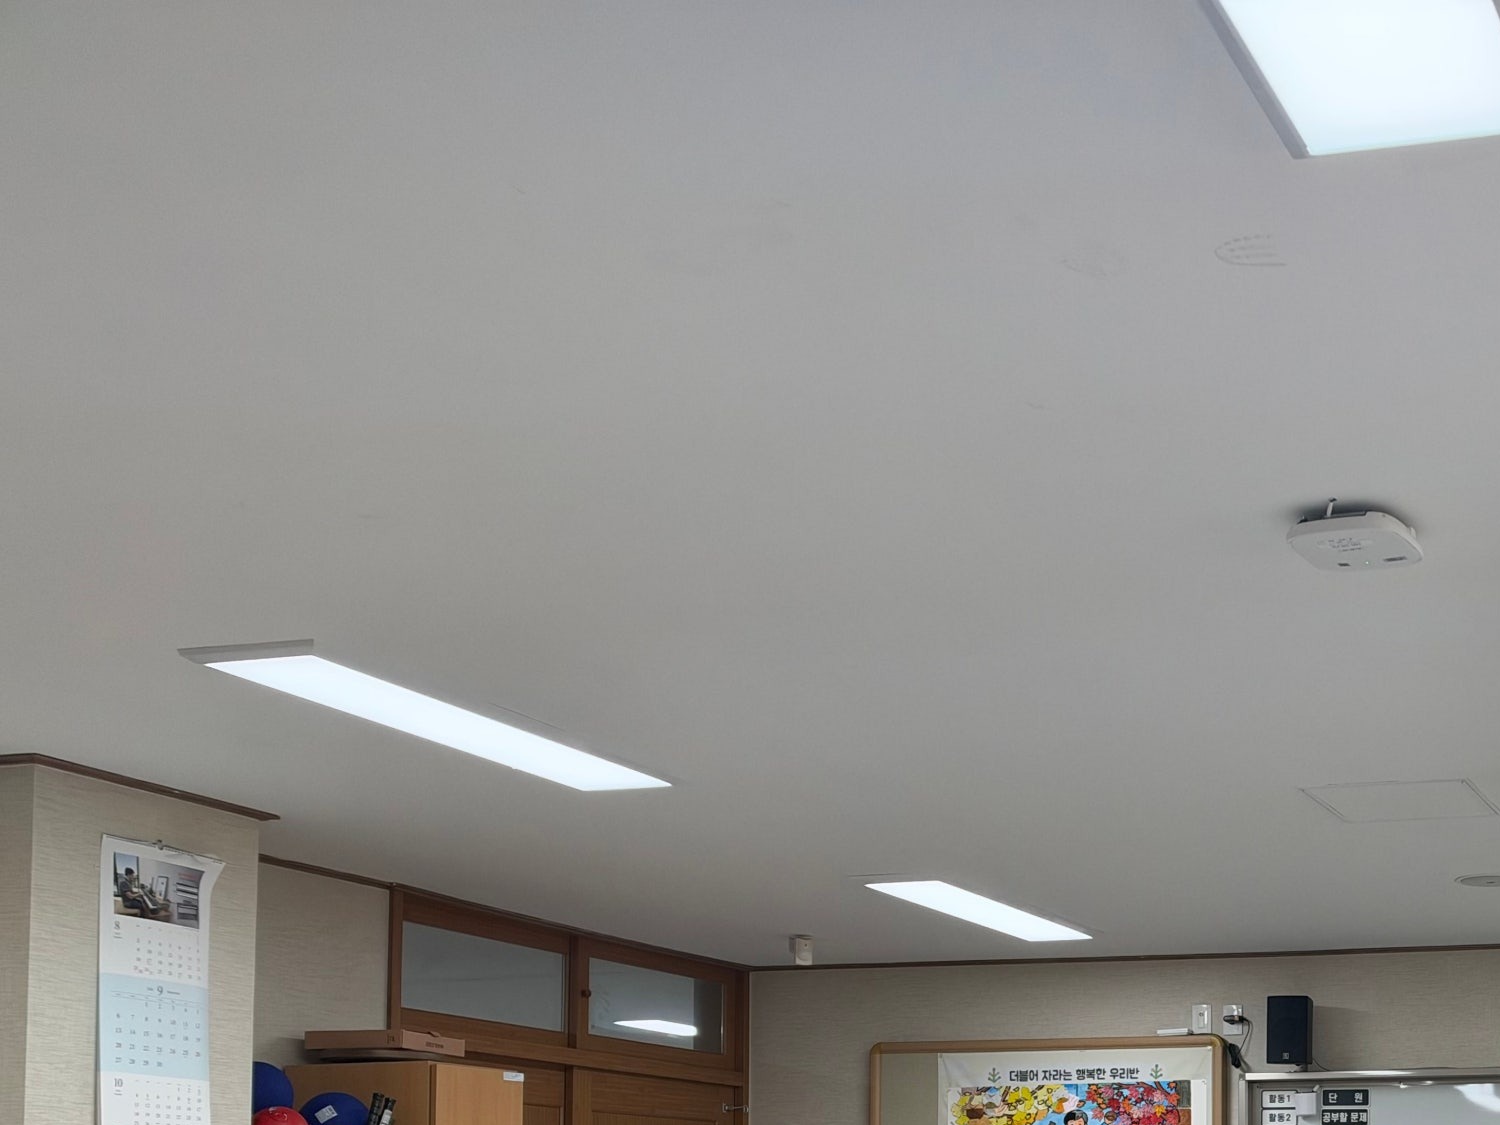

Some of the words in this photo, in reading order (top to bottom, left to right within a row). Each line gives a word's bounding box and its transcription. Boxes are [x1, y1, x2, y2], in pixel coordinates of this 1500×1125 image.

[1009, 1070, 1039, 1082] 더불어
[1041, 1069, 1073, 1081] 자라는
[1076, 1068, 1106, 1080] 행복한
[1109, 1067, 1140, 1079] 우리반
[1268, 1094, 1291, 1104] 활동1
[1268, 1113, 1291, 1122] 활동2
[1322, 1112, 1348, 1123] 공부할
[1350, 1112, 1367, 1123] 문제
